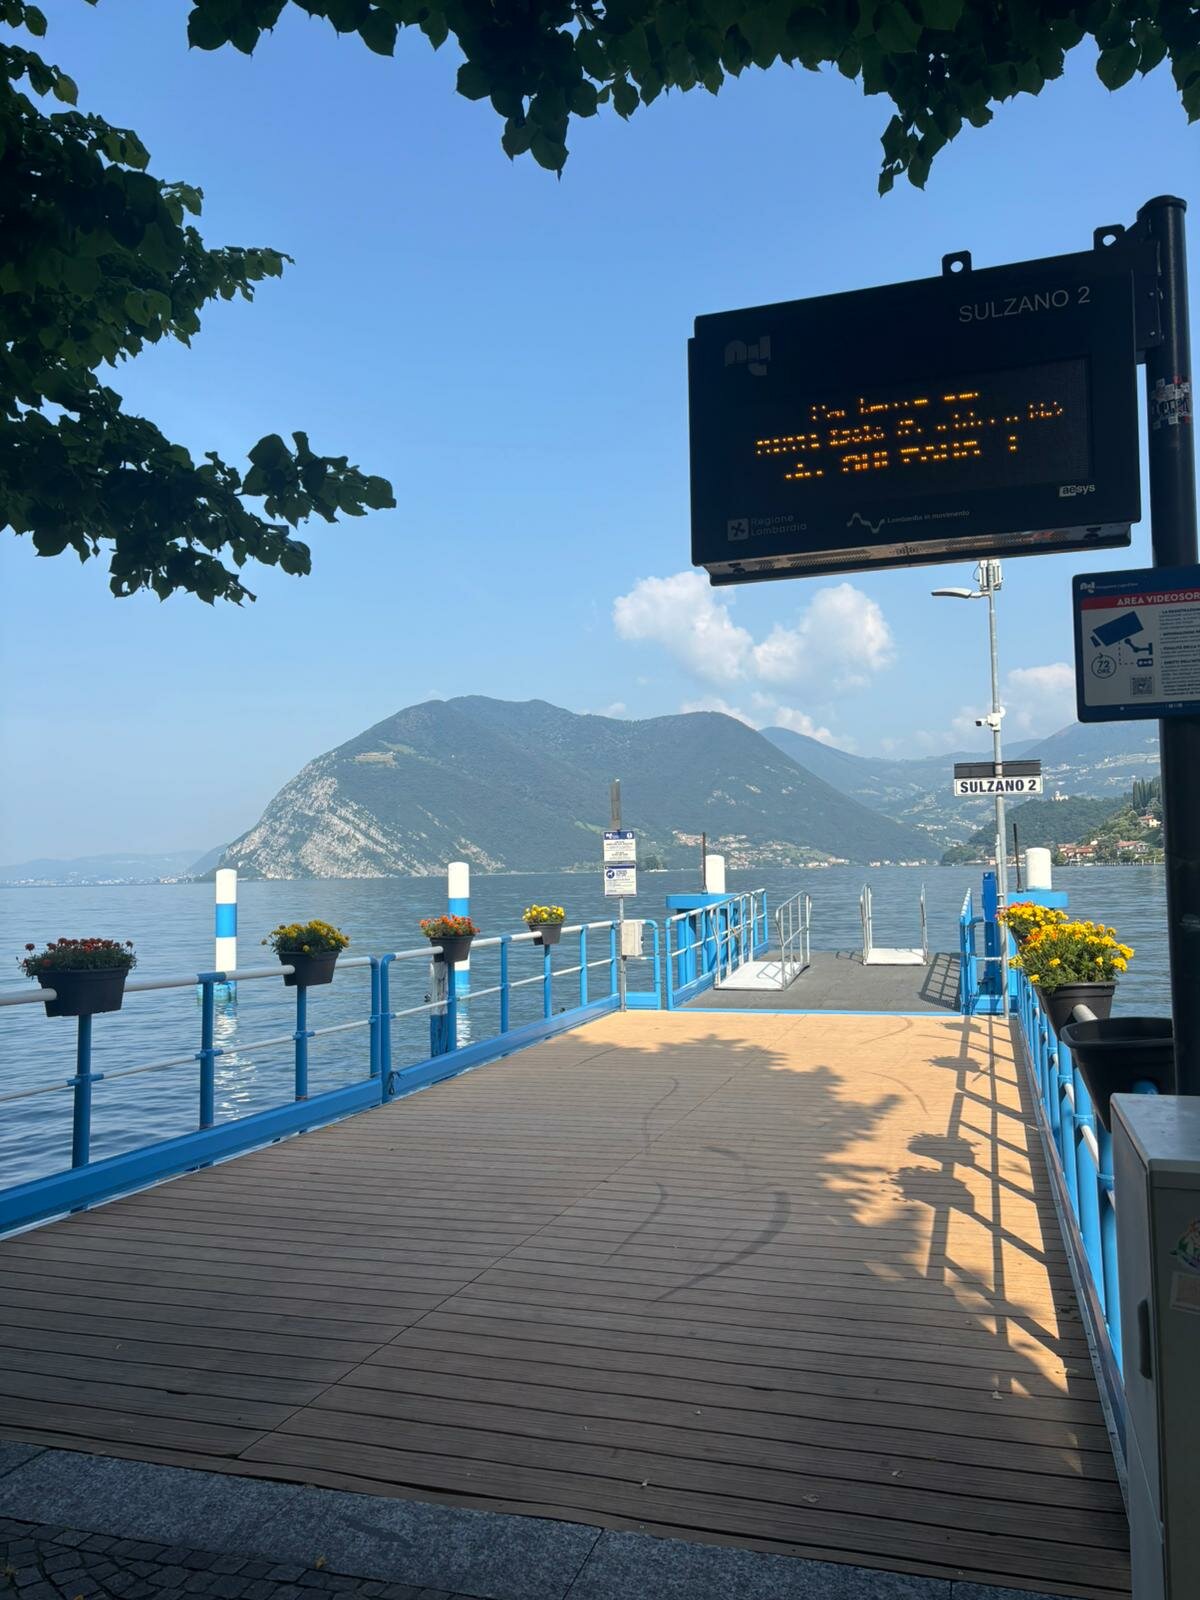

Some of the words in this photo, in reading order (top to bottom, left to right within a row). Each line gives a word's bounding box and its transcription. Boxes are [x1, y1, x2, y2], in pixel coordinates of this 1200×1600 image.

[959, 289, 1069, 322] SULZANO
[1077, 286, 1091, 304] 2
[1060, 484, 1096, 496] aesys
[1116, 598, 1145, 606] AREA
[1097, 660, 1110, 669] 72
[960, 779, 1024, 793] SULZANO
[1028, 779, 1037, 791] 2
